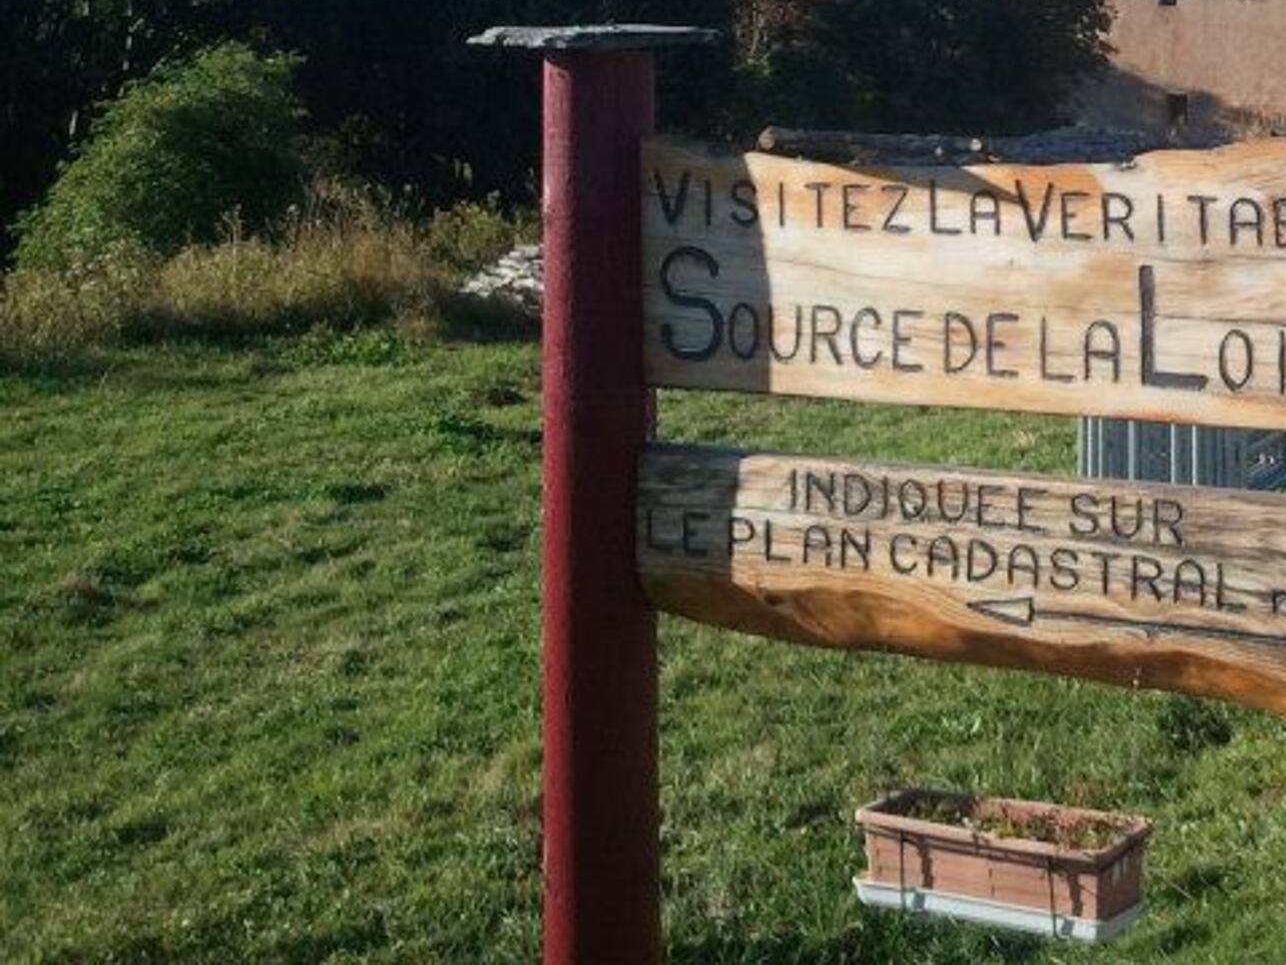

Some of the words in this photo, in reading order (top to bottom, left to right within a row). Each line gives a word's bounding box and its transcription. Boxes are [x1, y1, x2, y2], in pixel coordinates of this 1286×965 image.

[654, 169, 911, 233] VISITEZ
[929, 179, 1001, 235] LA
[944, 311, 1020, 378] DE
[1040, 316, 1120, 383] LA
[788, 468, 1048, 533] INDIQUEE
[1068, 493, 1184, 547] SUR
[647, 509, 711, 557] LE
[728, 516, 871, 571] PLAN
[889, 534, 1247, 613] CADASTRAL
